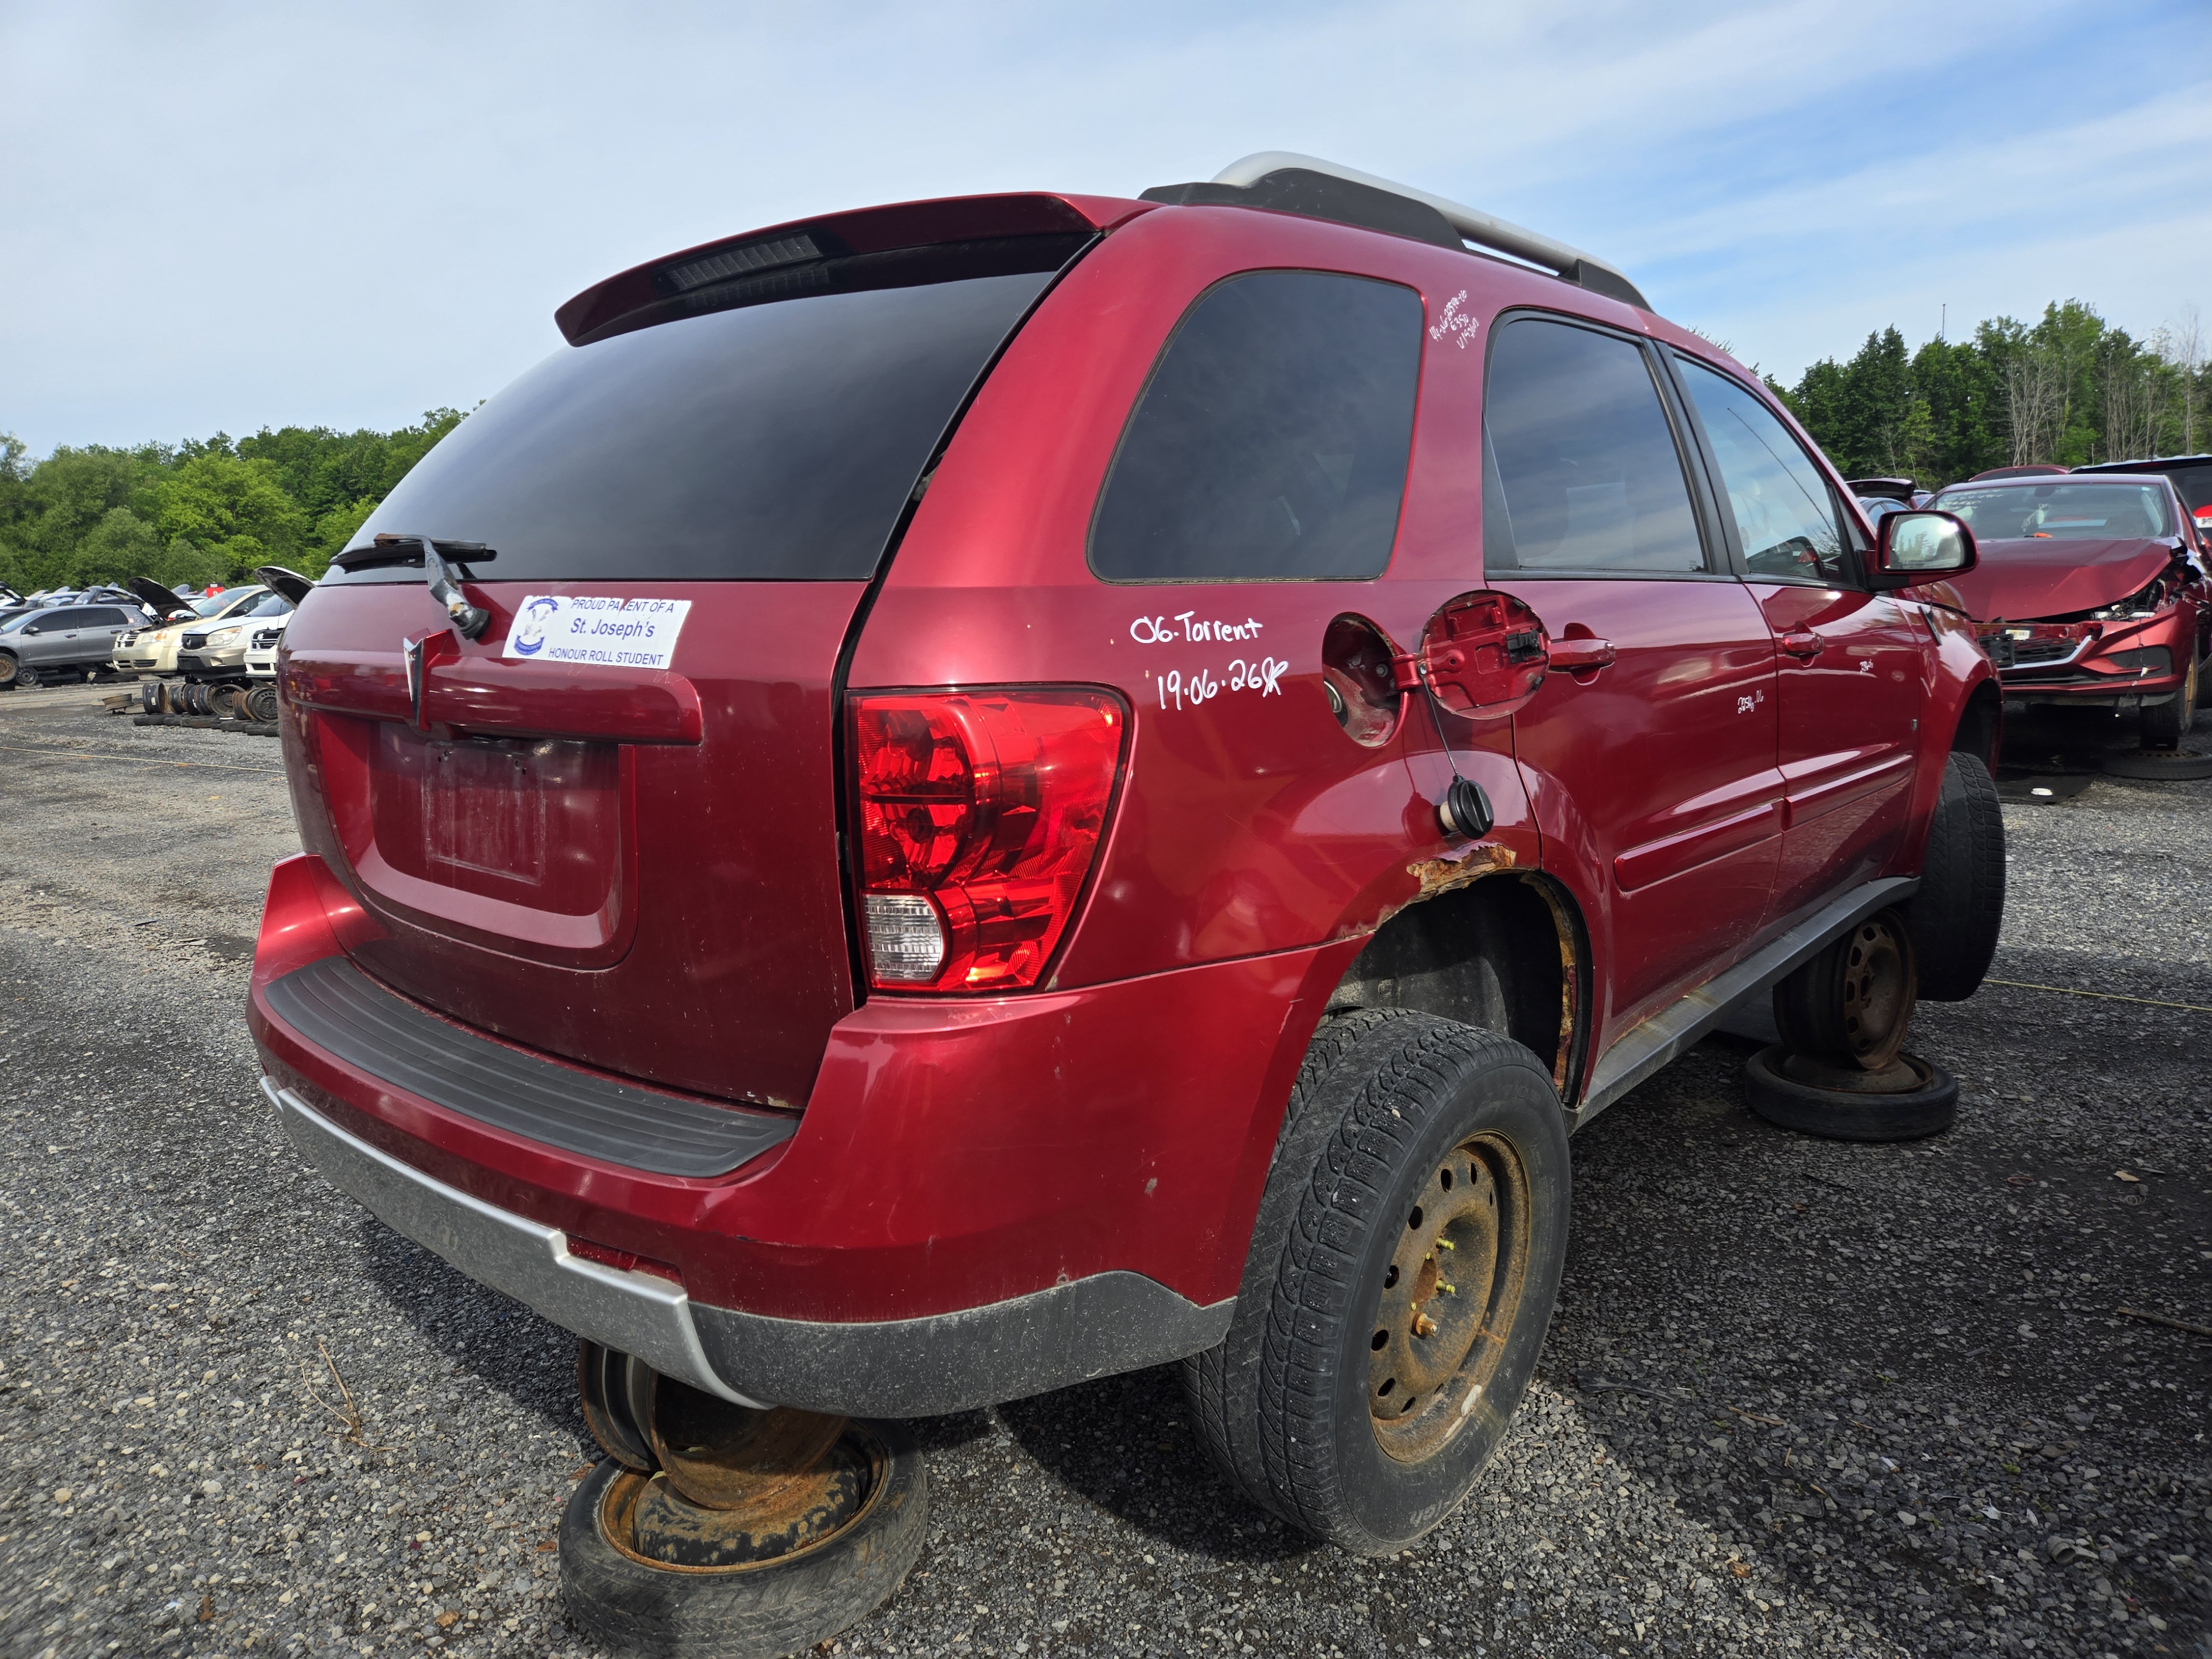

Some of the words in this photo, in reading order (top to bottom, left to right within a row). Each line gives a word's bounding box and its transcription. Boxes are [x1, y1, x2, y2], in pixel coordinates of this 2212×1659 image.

[571, 599, 606, 611] PROUD
[650, 602, 666, 612] OF
[665, 603, 674, 613] A
[570, 618, 587, 634] St.
[591, 619, 655, 640] Joseph's
[548, 648, 587, 660] HONOUR
[588, 649, 613, 662] ROLL
[616, 652, 664, 666] STUDENT
